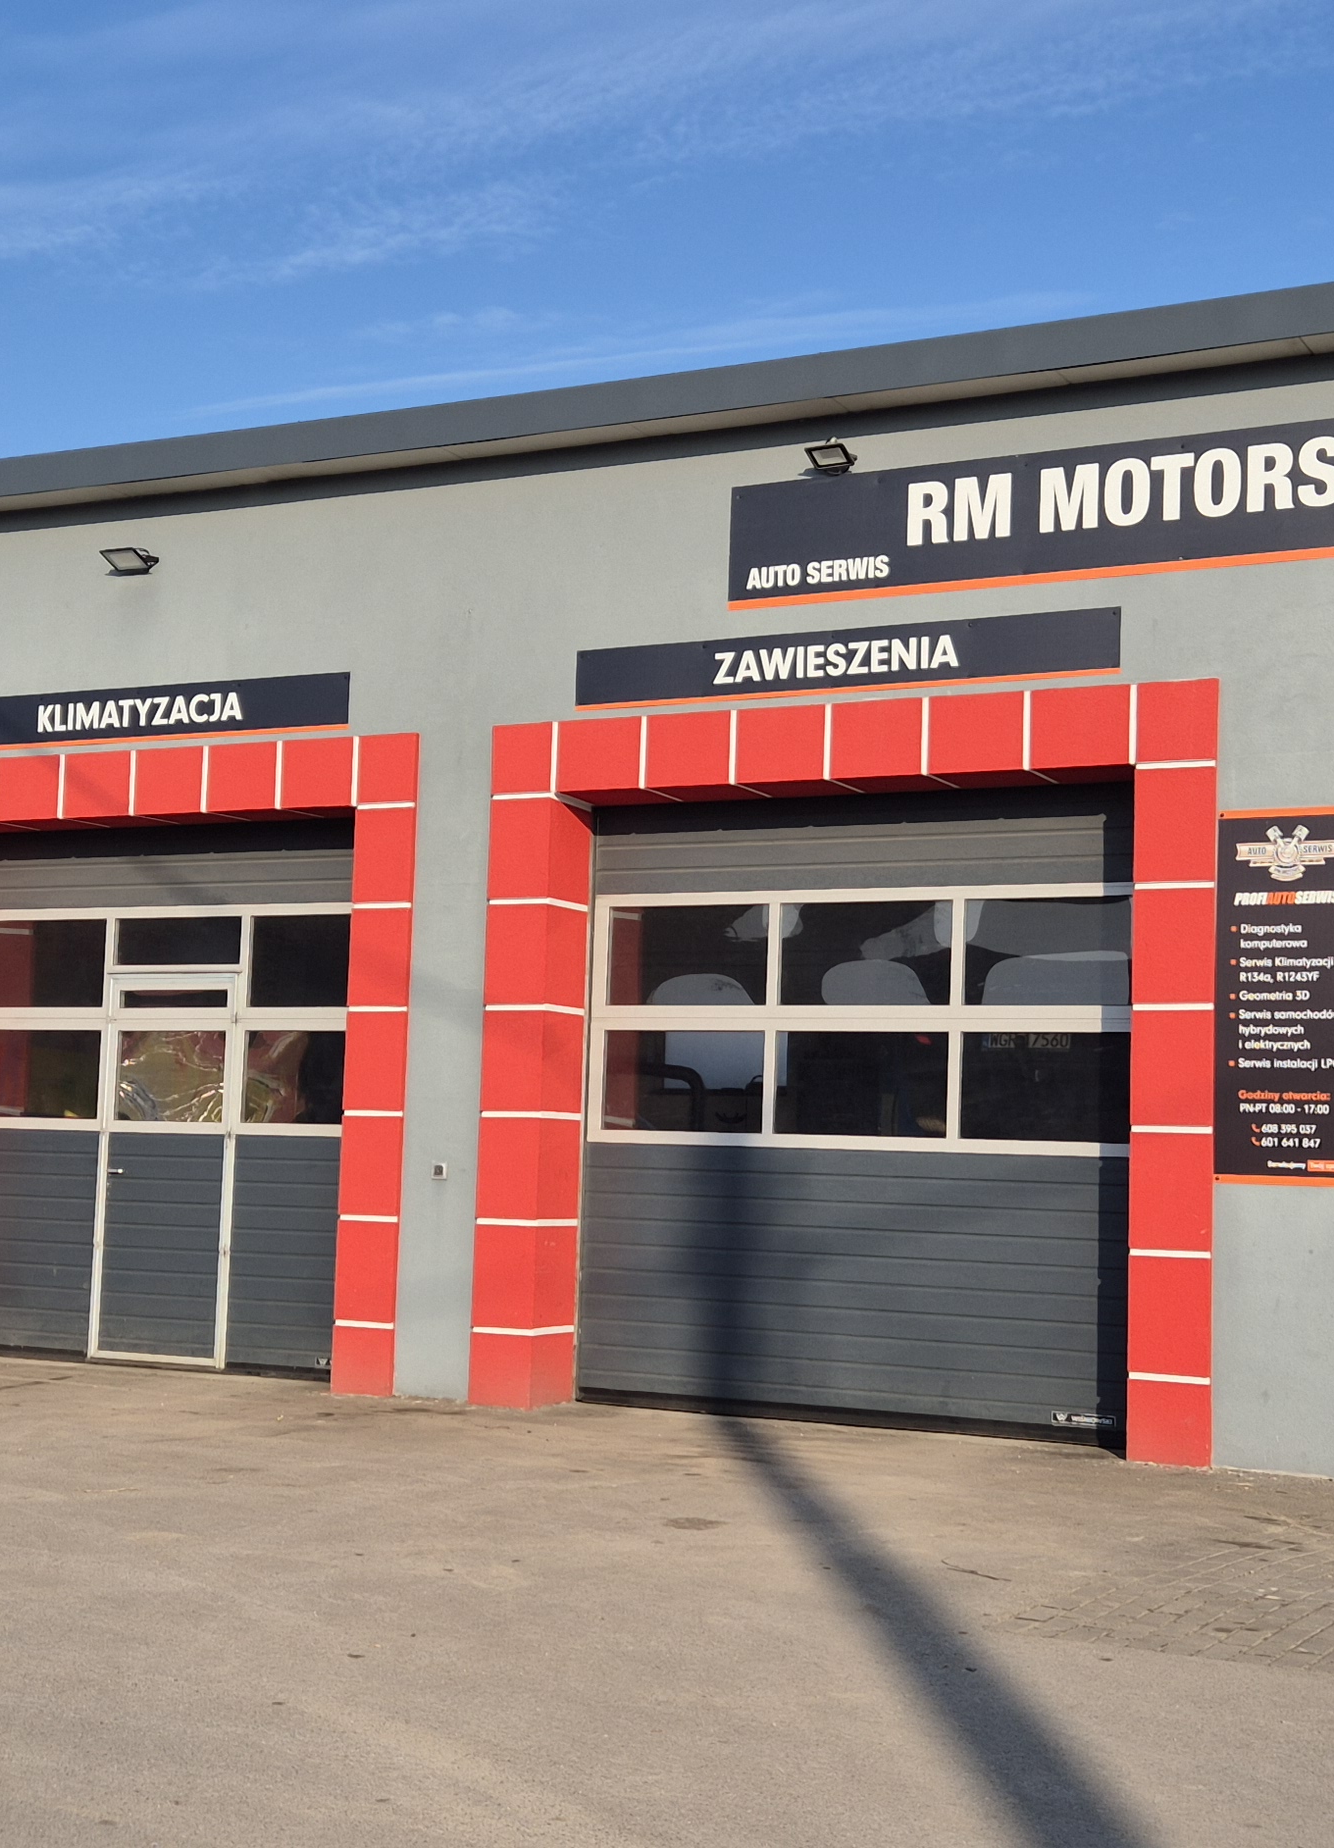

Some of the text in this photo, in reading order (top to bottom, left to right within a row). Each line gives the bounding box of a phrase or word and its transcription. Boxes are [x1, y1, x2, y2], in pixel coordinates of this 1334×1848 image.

[906, 472, 1012, 546] RM
[746, 555, 890, 590] AUTO SERWIS
[713, 634, 959, 685] ZAWIESZENIA
[37, 692, 243, 733] KLIMATYZACJA
[1247, 845, 1333, 855] AUTO SERWIS
[1240, 923, 1302, 936] Diagnostyka
[1240, 939, 1308, 951] komputerowa
[1239, 956, 1334, 969] Serwis Klimatyzacji
[1239, 990, 1310, 1000] Geometria 3D
[1238, 1009, 1272, 1019] Serwis
[1238, 1024, 1304, 1037] hybrydowych
[1244, 1039, 1311, 1052] elektrycznych
[1238, 1058, 1271, 1068] Serwis
[1274, 1058, 1318, 1071] instalacji
[1238, 1090, 1331, 1102] Godziny otwarcia:
[1239, 1103, 1267, 1113] PN-PT
[1269, 1103, 1295, 1114] 08:00
[1304, 1104, 1329, 1114] 17:00
[1261, 1137, 1278, 1147] 601
[1281, 1138, 1299, 1147] 641
